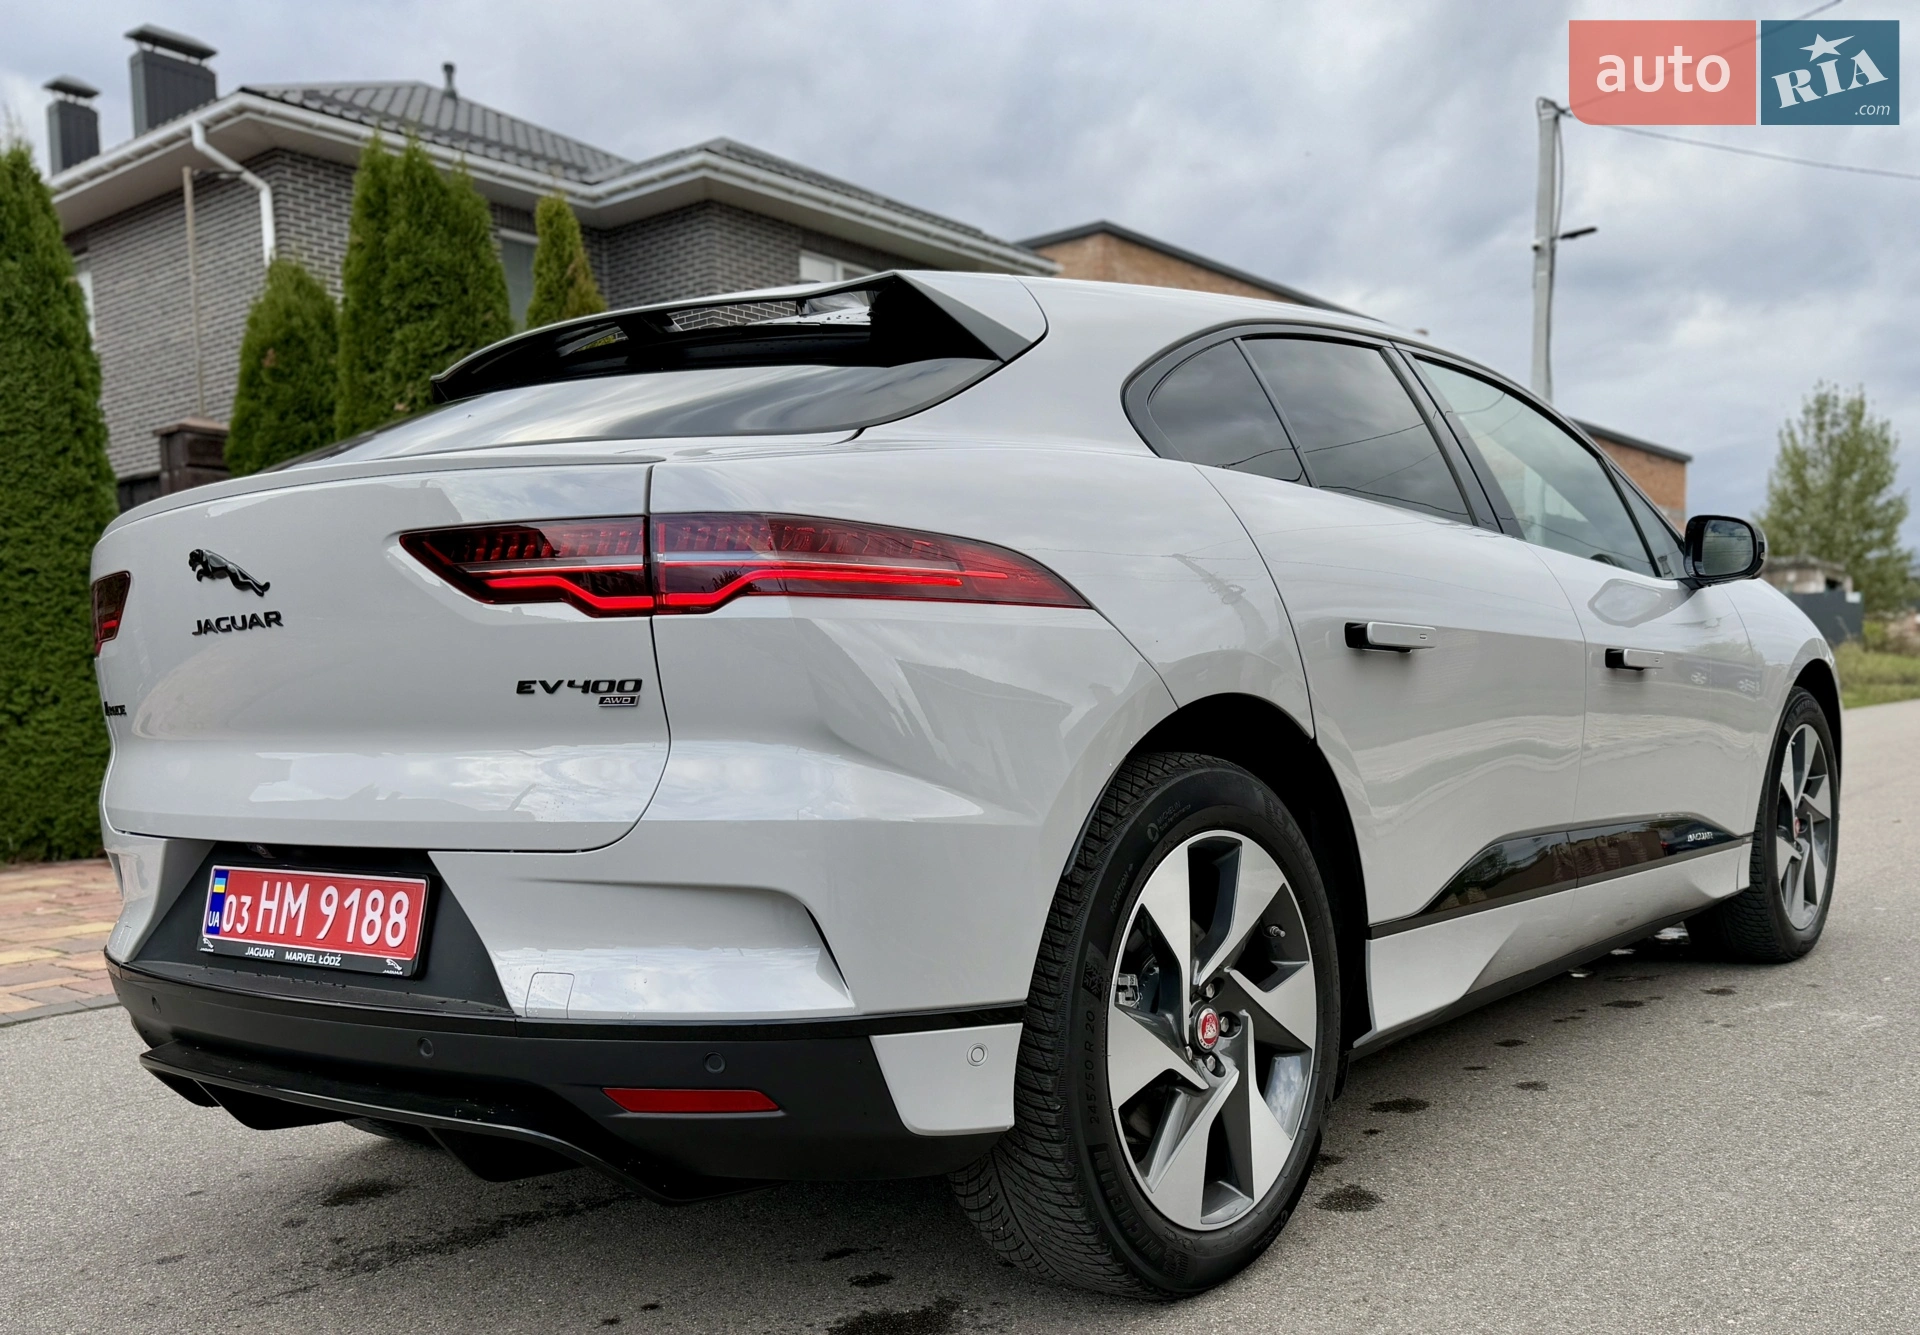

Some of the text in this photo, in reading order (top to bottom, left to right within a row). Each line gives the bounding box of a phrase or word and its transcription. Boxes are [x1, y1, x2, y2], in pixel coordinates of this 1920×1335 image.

[192, 611, 284, 636] JAGUAR
[516, 679, 643, 694] EV400
[208, 911, 220, 928] UA
[222, 880, 410, 948] 03 HM 9188
[245, 946, 341, 966] JAGUAR MARVEL ŁÓDŹ
[1084, 1010, 1100, 1125] 245/50 R 20
